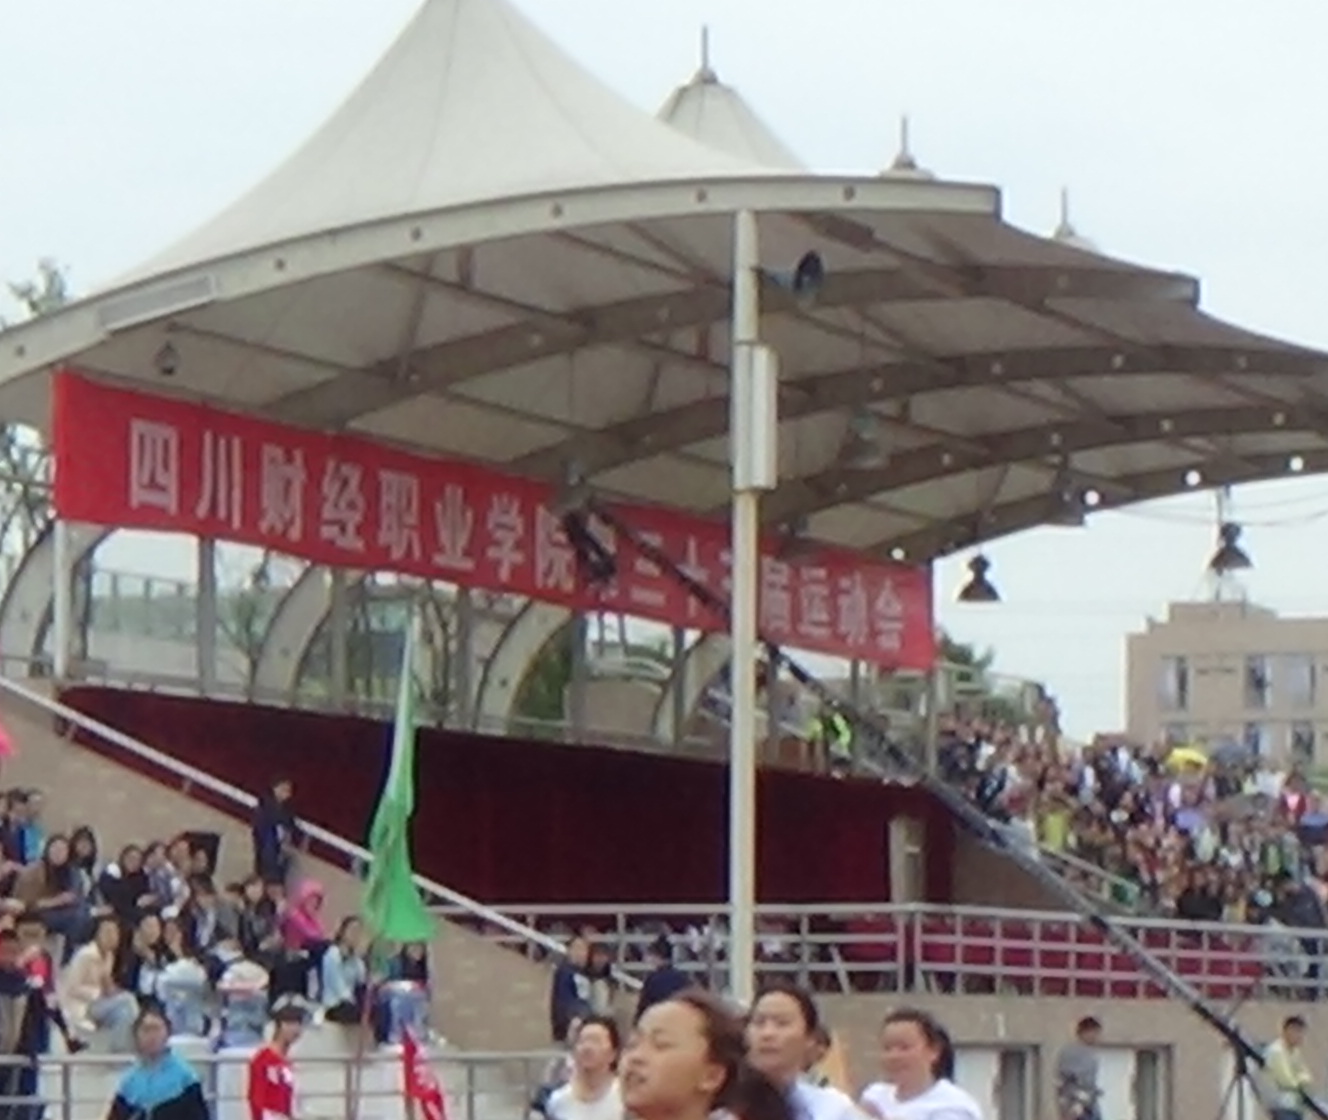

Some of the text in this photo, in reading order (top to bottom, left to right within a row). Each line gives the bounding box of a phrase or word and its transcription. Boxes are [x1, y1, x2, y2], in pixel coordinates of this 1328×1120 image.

[129, 417, 904, 652] 四川财经职业学院三十届运动会
